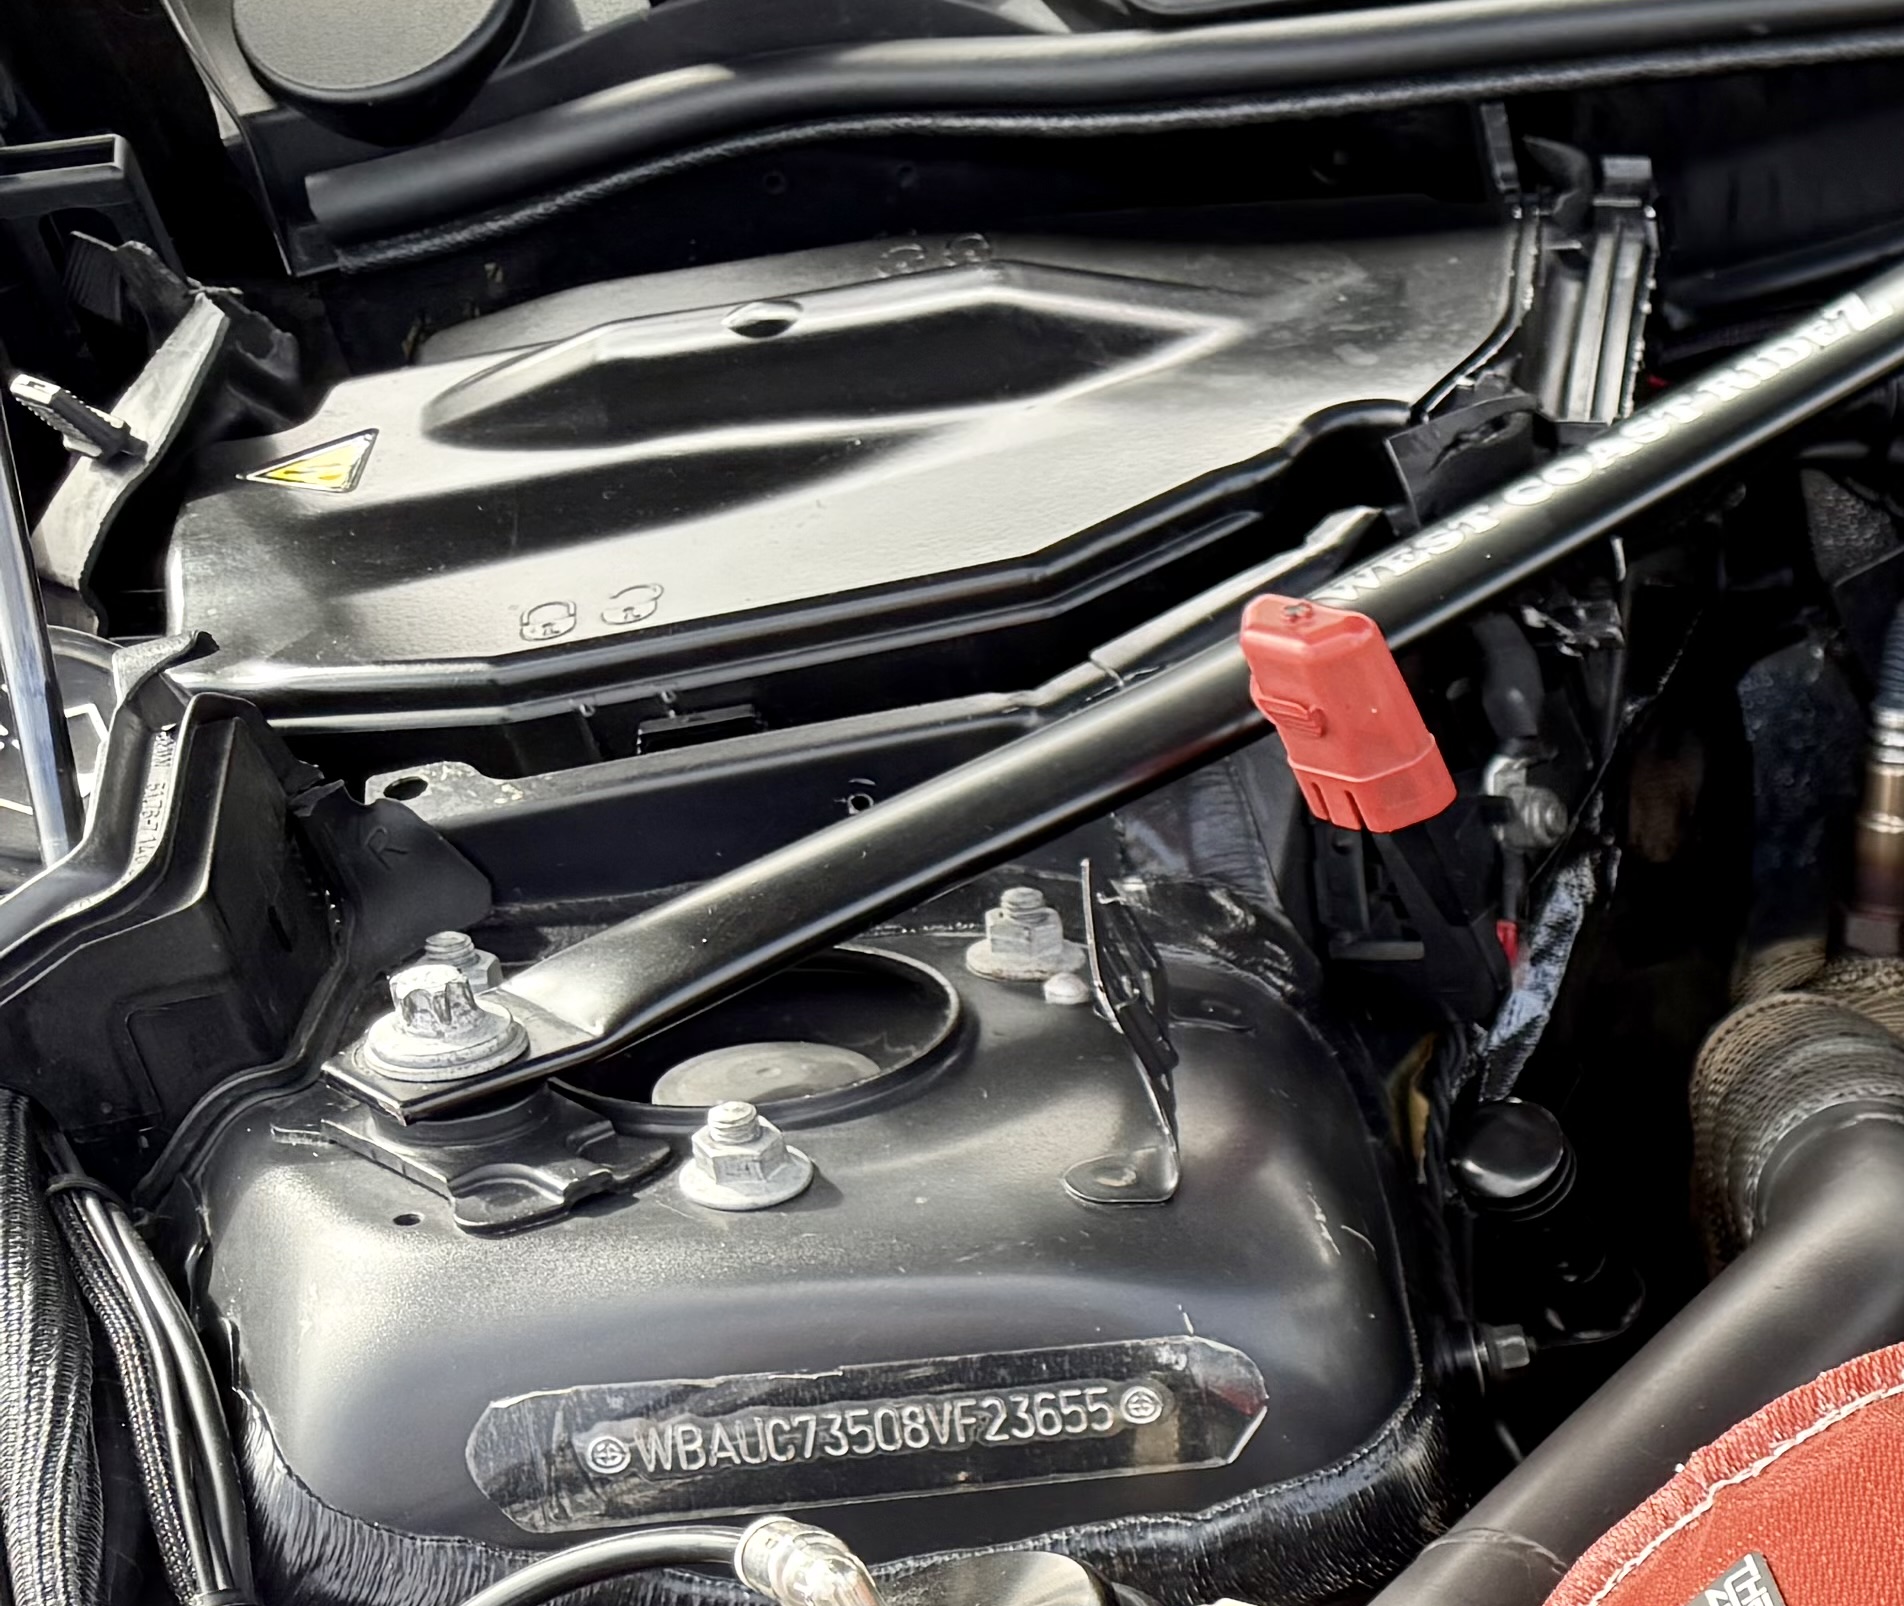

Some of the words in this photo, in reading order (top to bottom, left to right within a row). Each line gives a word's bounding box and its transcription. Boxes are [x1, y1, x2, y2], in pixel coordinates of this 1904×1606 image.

[1317, 503, 1501, 602] WEST
[1502, 400, 1704, 508] COAST
[1697, 292, 1895, 402] RIDEZ
[633, 1385, 1113, 1474] WBAUC73508VF23655
